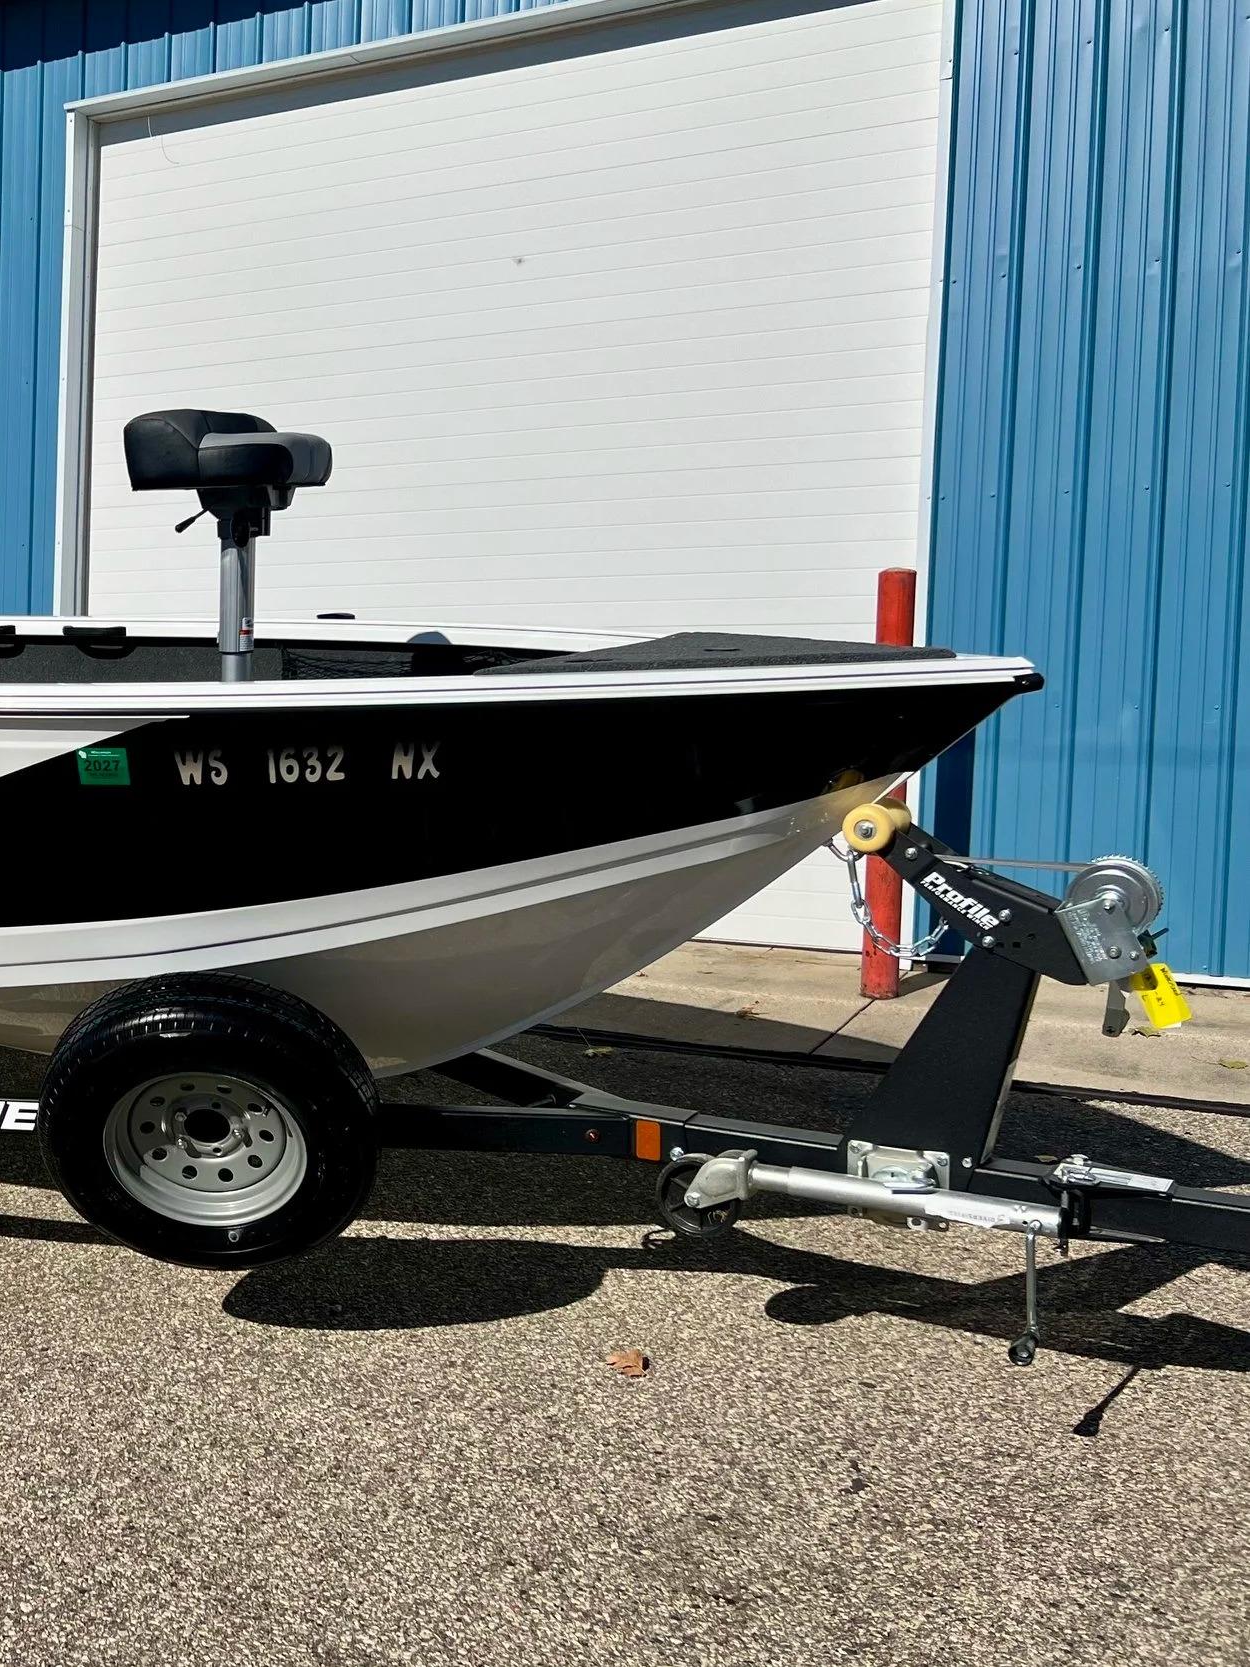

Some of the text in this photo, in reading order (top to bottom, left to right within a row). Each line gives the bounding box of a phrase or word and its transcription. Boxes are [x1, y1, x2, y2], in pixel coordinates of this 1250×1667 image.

[84, 760, 120, 771] 2027
[174, 741, 440, 786] WS 1632 NX
[919, 880, 994, 931] PERFORMANCE WINCH
[923, 871, 1000, 926] Profile
